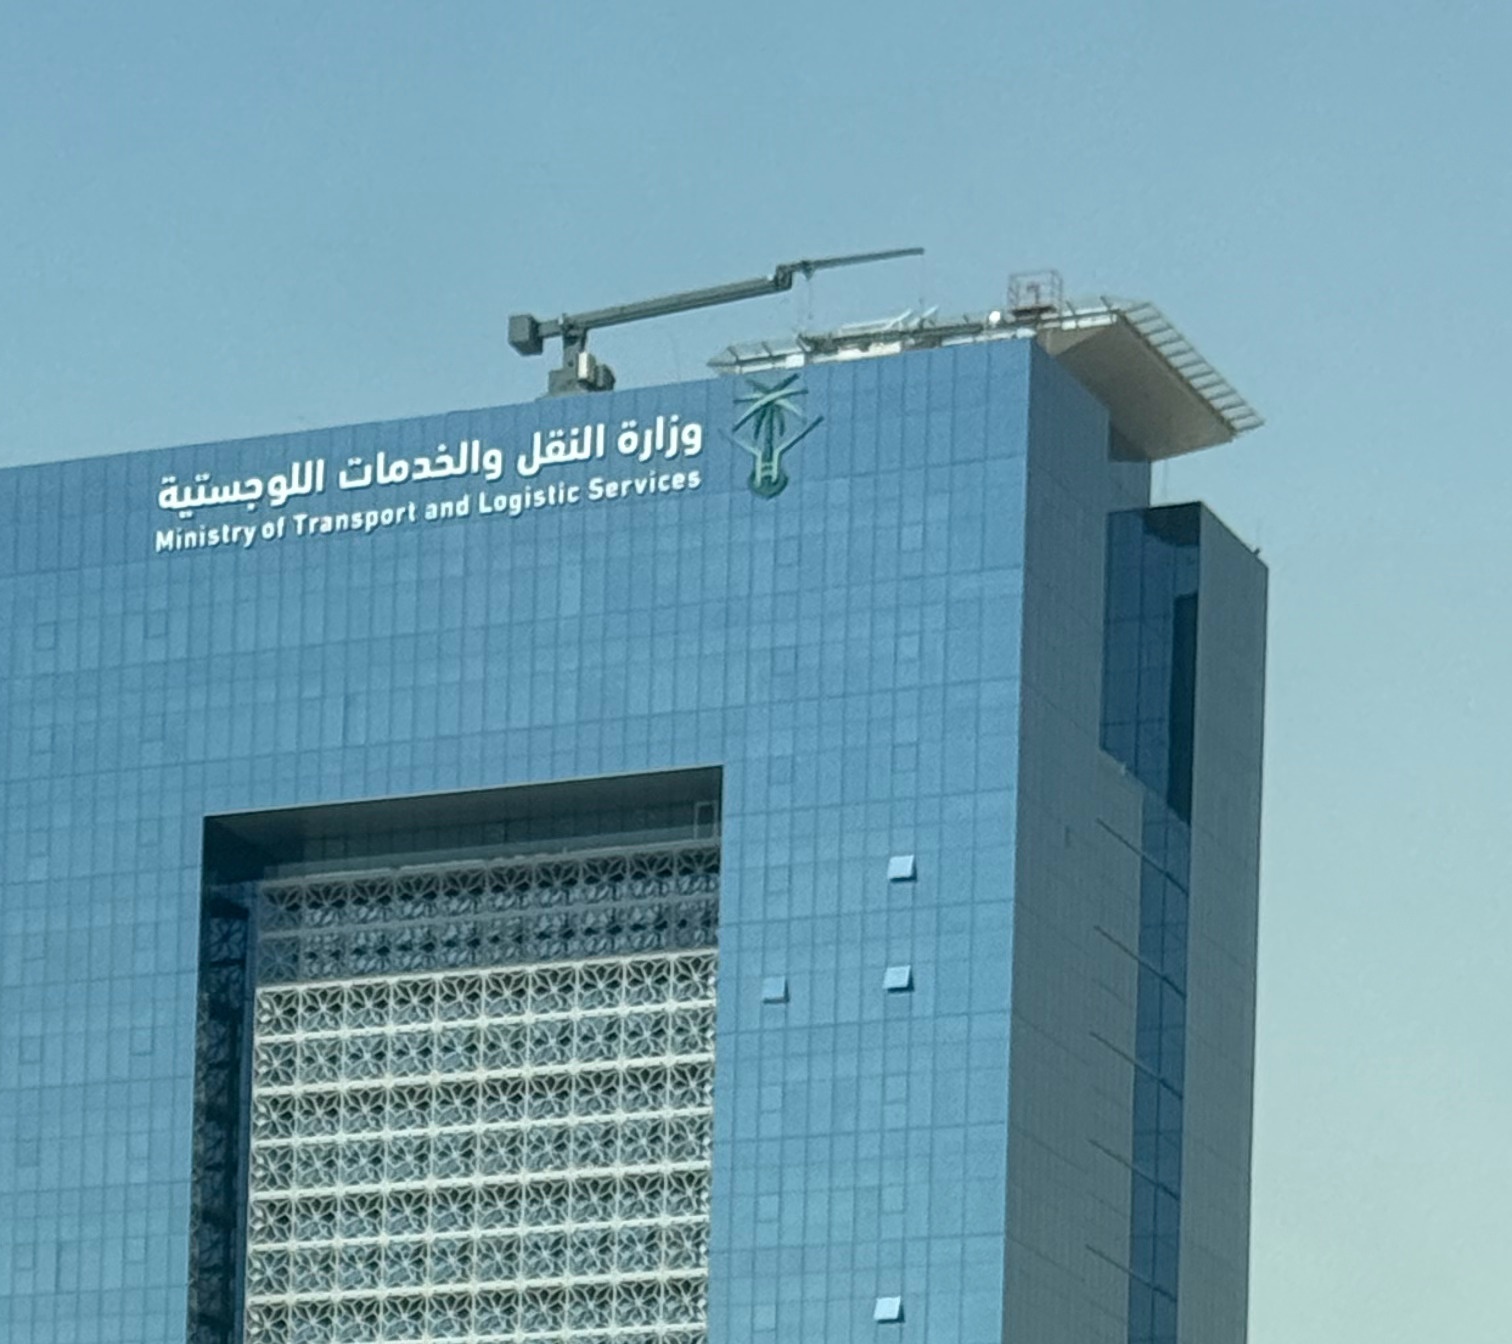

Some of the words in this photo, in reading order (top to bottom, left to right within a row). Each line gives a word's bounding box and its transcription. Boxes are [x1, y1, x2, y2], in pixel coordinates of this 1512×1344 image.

[338, 439, 503, 490] والخدمات
[517, 423, 606, 477] النقل
[617, 415, 703, 462] وزارة
[156, 523, 256, 552] Ministry
[261, 516, 286, 540] of
[293, 501, 417, 535] Transport
[424, 493, 470, 521] and
[478, 481, 581, 517] Logistic
[588, 470, 702, 500] Services
[157, 458, 326, 519] اللوجستية
